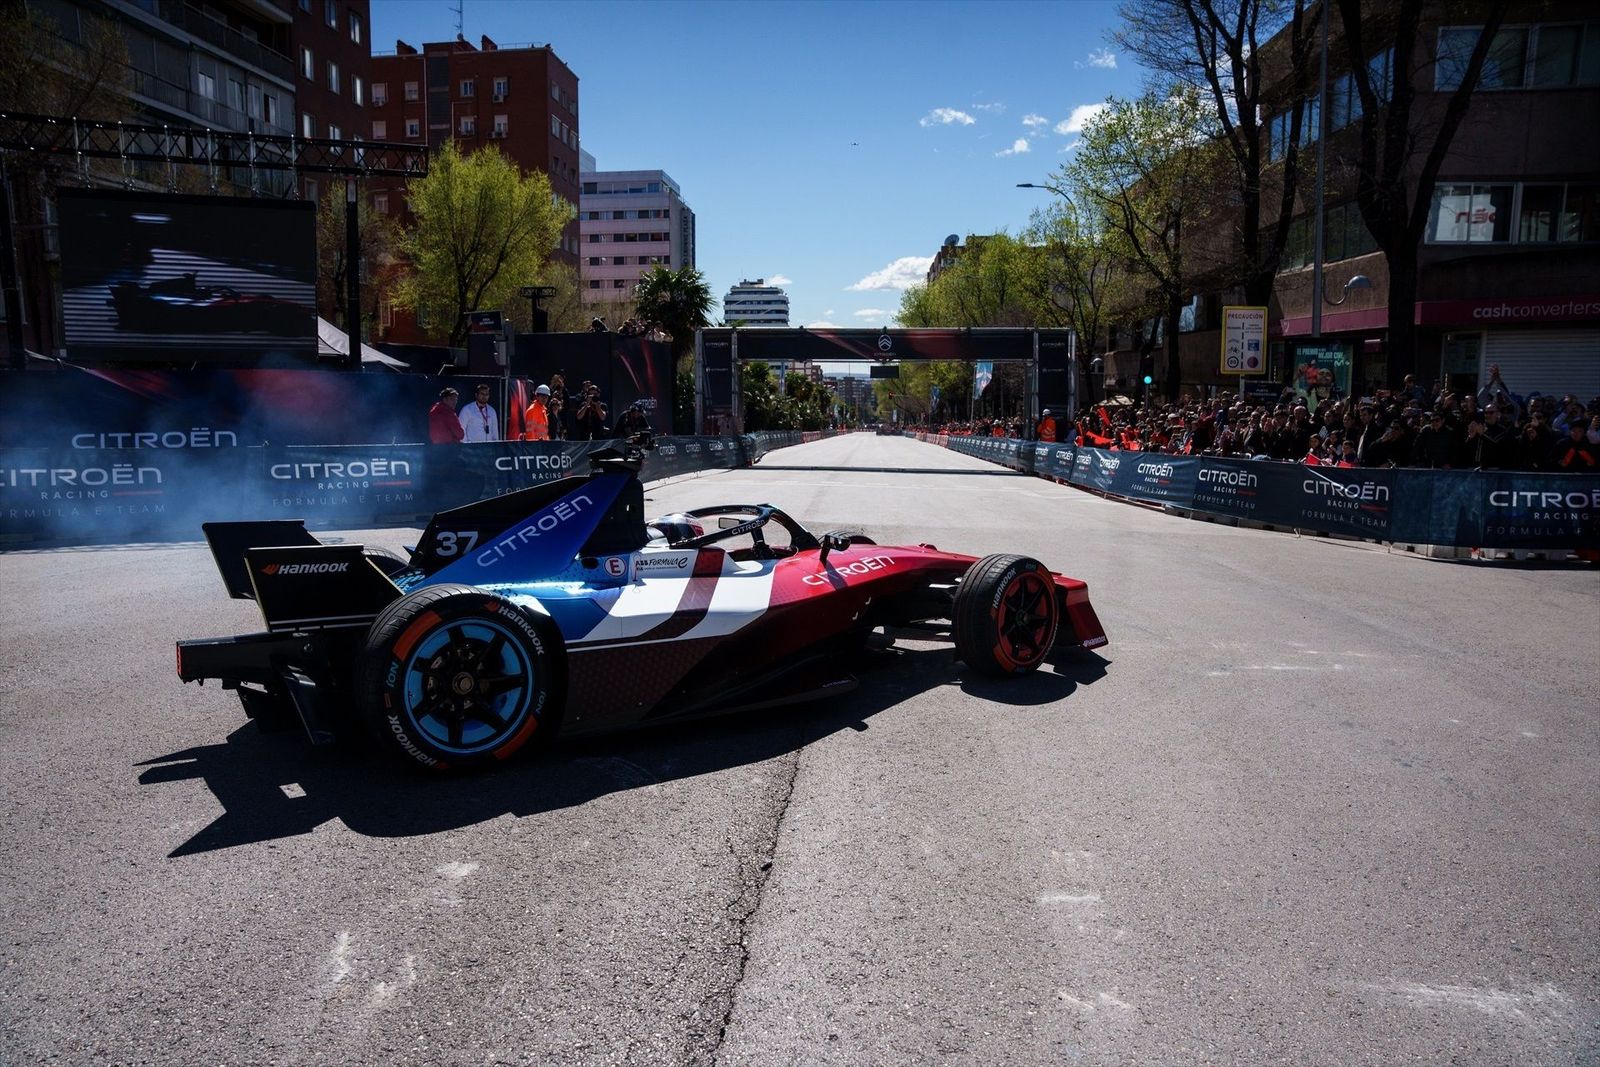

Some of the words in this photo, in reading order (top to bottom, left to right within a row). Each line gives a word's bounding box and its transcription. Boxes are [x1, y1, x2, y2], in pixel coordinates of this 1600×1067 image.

[1473, 301, 1600, 319] cashconverters
[71, 427, 237, 449] CITROËN
[270, 458, 410, 479] CITROËN
[495, 452, 572, 470] CITROËN
[0, 464, 162, 487] ITROËN
[532, 472, 561, 480] RACING
[1137, 463, 1174, 477] CITROËN
[318, 481, 369, 490] RACING
[1198, 469, 1258, 488] CITROËN
[41, 490, 109, 500] RACING
[1213, 485, 1237, 495] RACING
[1303, 480, 1389, 502] CITROËN
[272, 497, 348, 508] FORMULA
[359, 495, 365, 503] E
[376, 493, 414, 504] TEAM
[1193, 494, 1225, 505] FORMULA
[1327, 500, 1359, 510] RACING
[116, 504, 166, 515] TEAM
[1534, 512, 1590, 520] RACING
[1302, 510, 1345, 523] FORMULA
[1361, 516, 1387, 528] TEAM
[477, 494, 593, 567] CITROËN
[731, 519, 766, 535] CITROËN
[1487, 526, 1565, 537] FORMULA
[436, 531, 478, 557] 37
[610, 559, 621, 574] E
